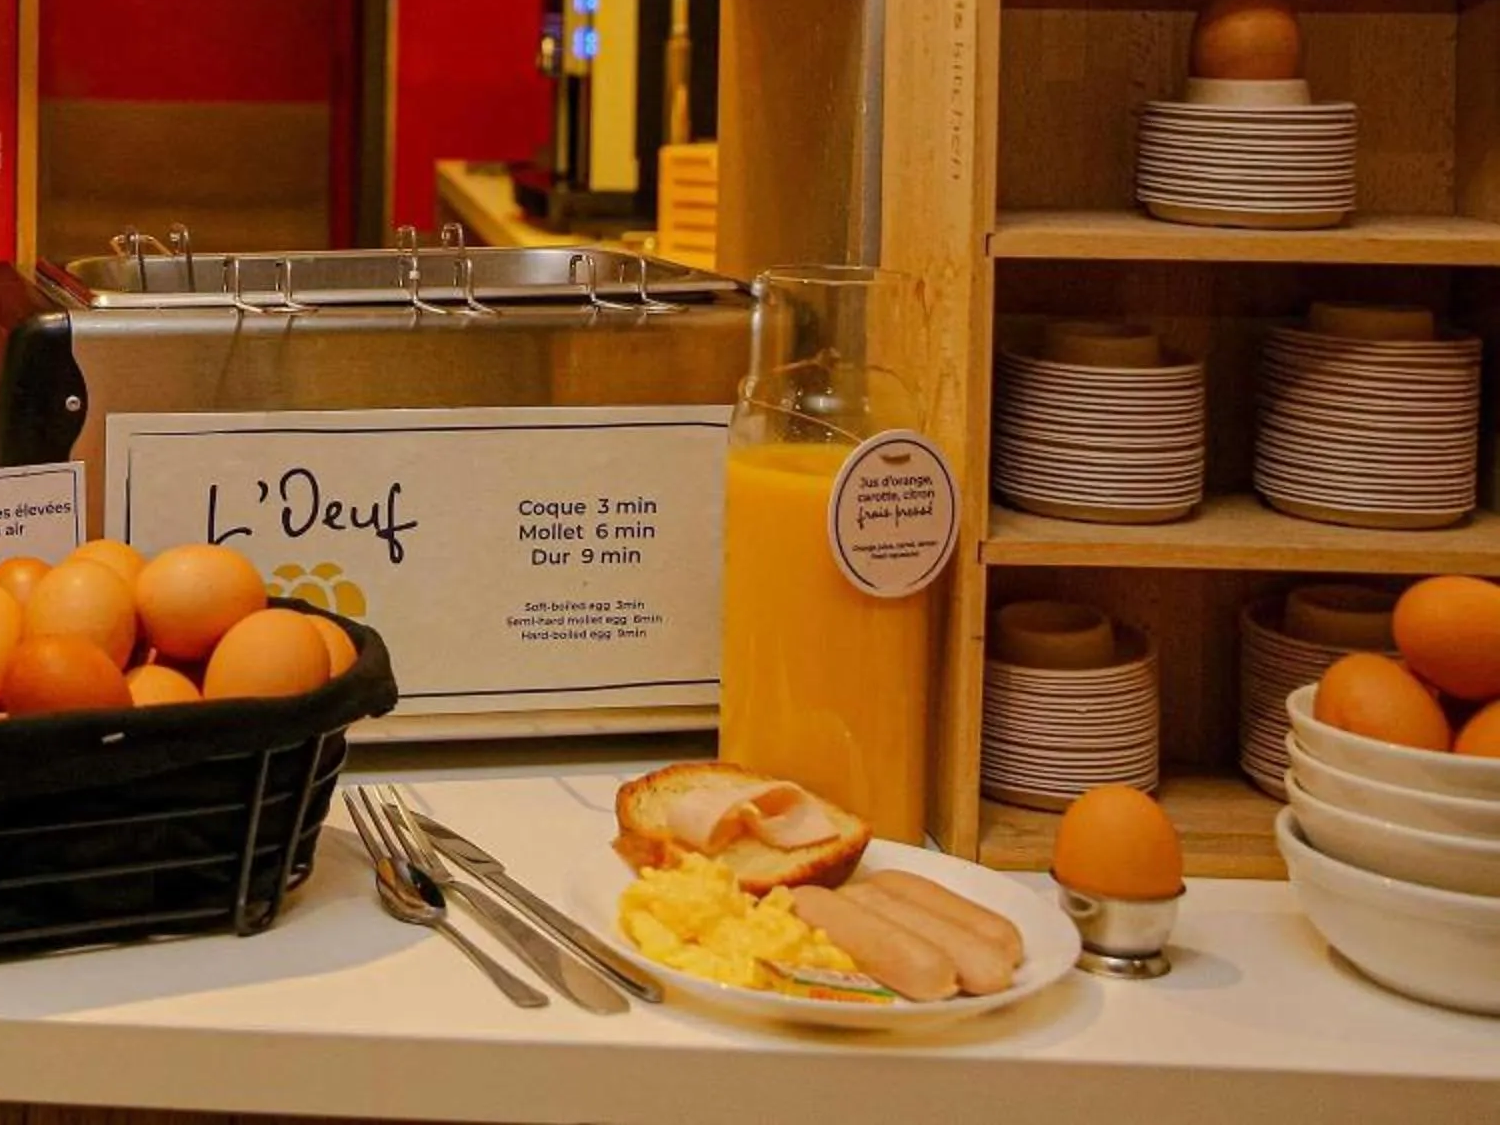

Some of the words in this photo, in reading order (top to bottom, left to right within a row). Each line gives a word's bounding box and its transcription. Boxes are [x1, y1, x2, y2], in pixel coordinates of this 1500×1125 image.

[14, 500, 72, 518] élevées
[518, 498, 587, 520] Coque
[597, 498, 610, 516] 3
[615, 497, 658, 515] min
[5, 524, 25, 537] air
[519, 522, 584, 541] Mollet
[595, 522, 609, 540] 6
[615, 521, 656, 539] min
[531, 548, 571, 566] Dur
[581, 547, 595, 565] 9
[601, 546, 642, 564] min
[605, 616, 627, 626] egg
[589, 631, 612, 641] egg
